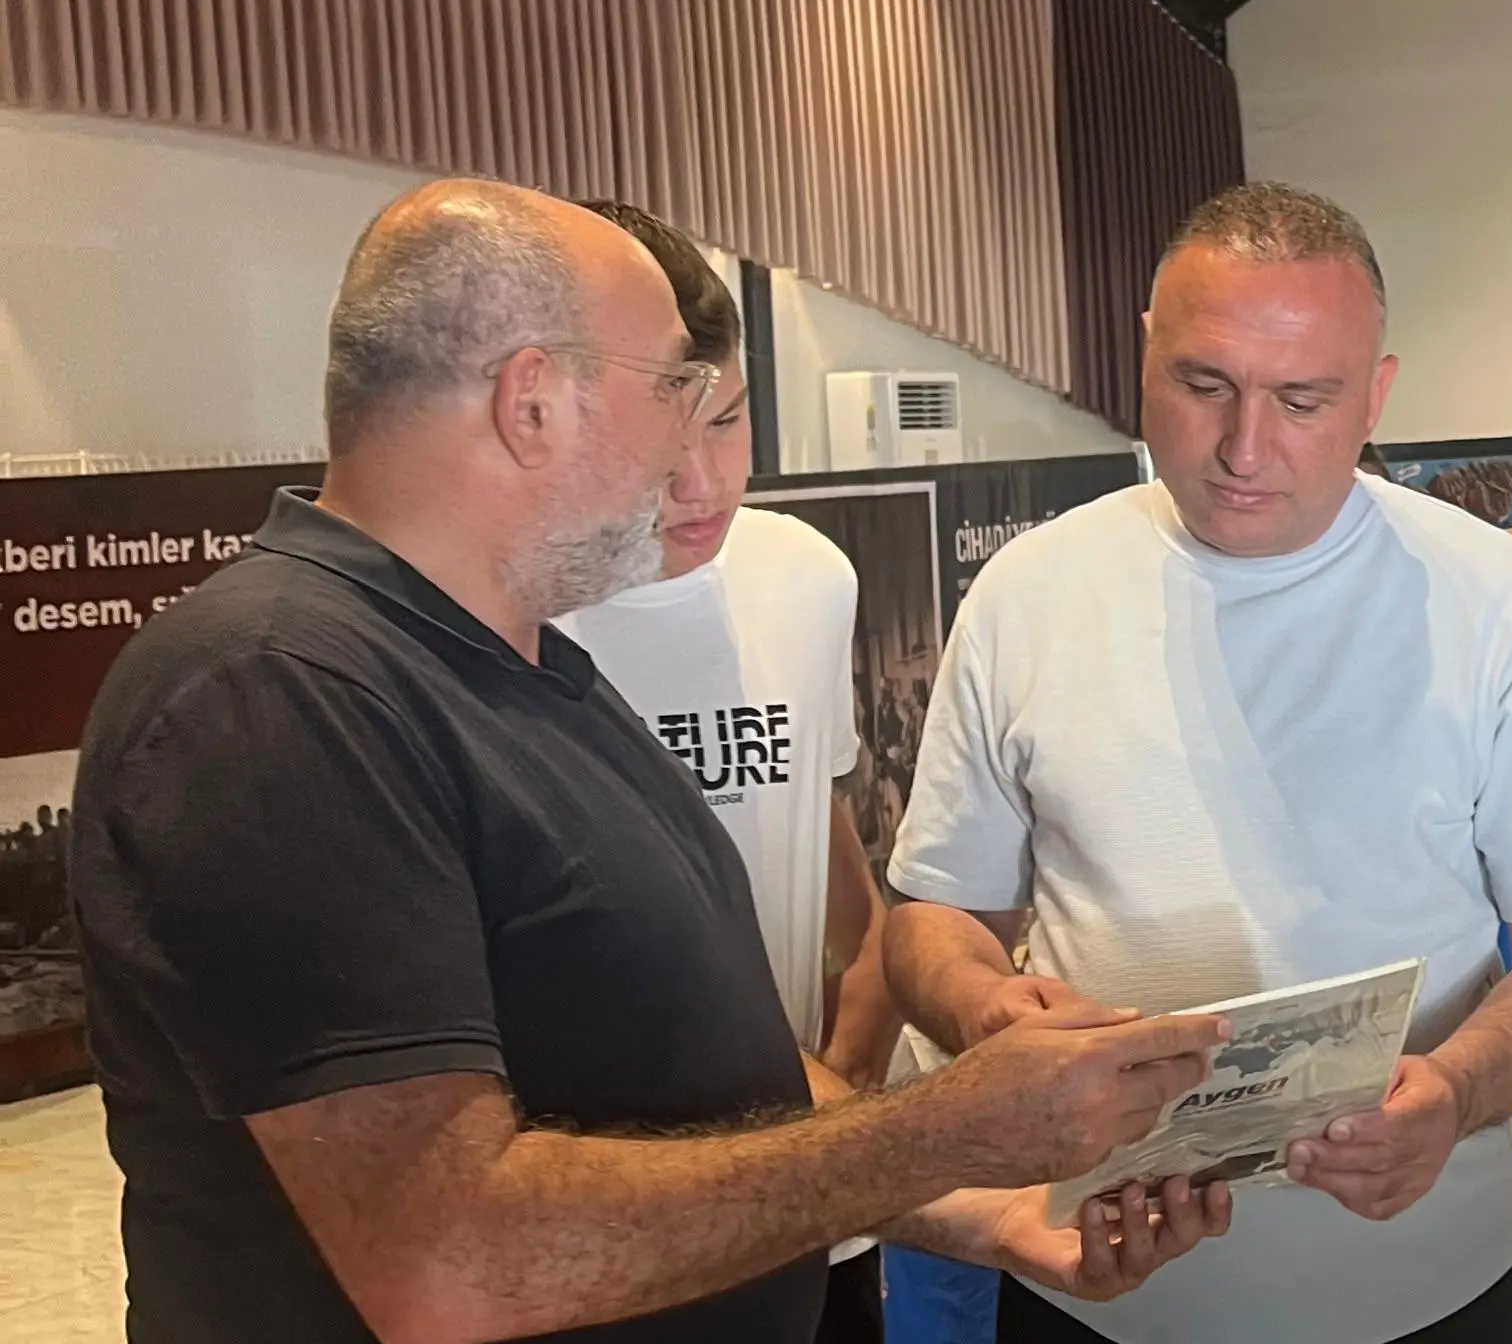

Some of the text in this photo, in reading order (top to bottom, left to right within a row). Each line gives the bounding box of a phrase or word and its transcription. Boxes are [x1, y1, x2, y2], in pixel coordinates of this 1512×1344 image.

[0, 528, 254, 574] beri kimler ka
[13, 597, 143, 631] desem,
